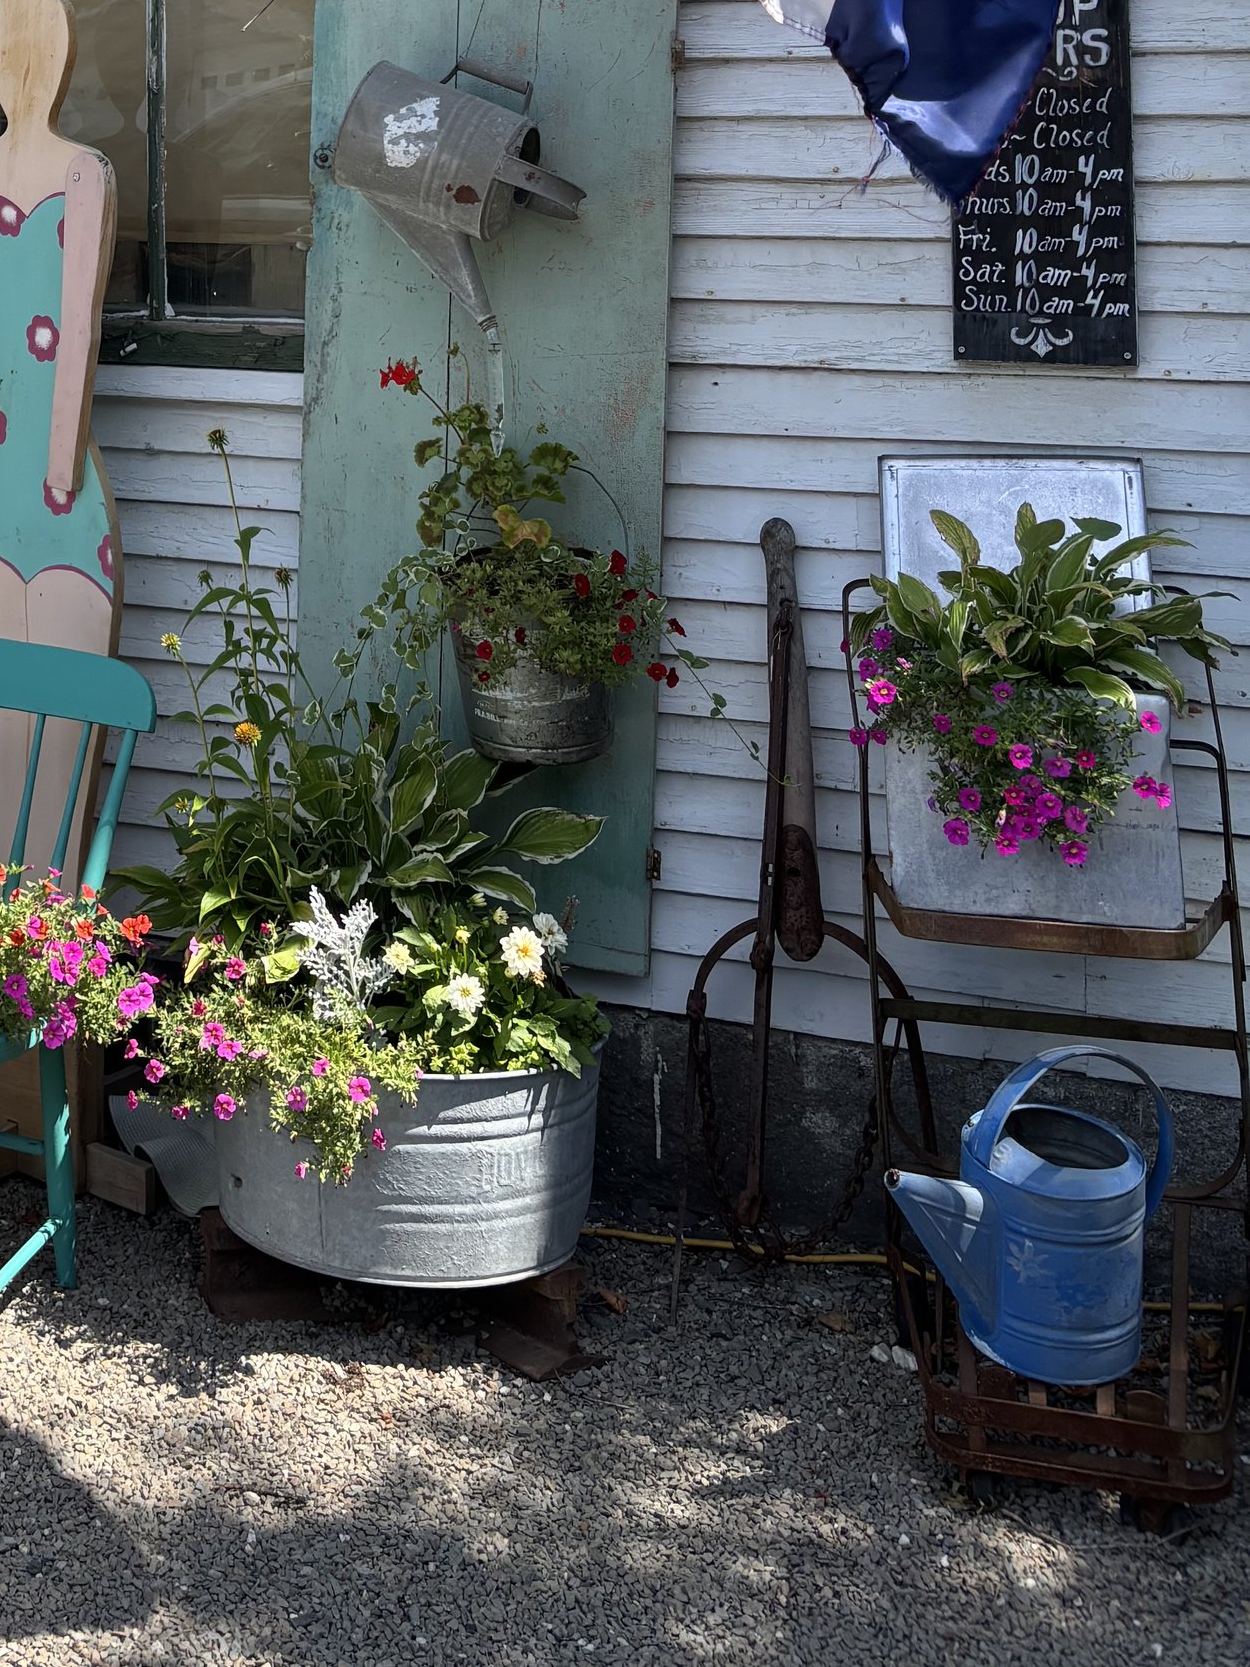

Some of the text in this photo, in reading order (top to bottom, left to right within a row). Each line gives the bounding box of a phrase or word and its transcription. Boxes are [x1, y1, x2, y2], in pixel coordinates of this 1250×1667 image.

[1034, 86, 1113, 116] Closed
[1033, 121, 1112, 149] Closed
[957, 222, 997, 253] Fri.
[958, 256, 1006, 283] Sat.
[960, 285, 1012, 311] Sun.
